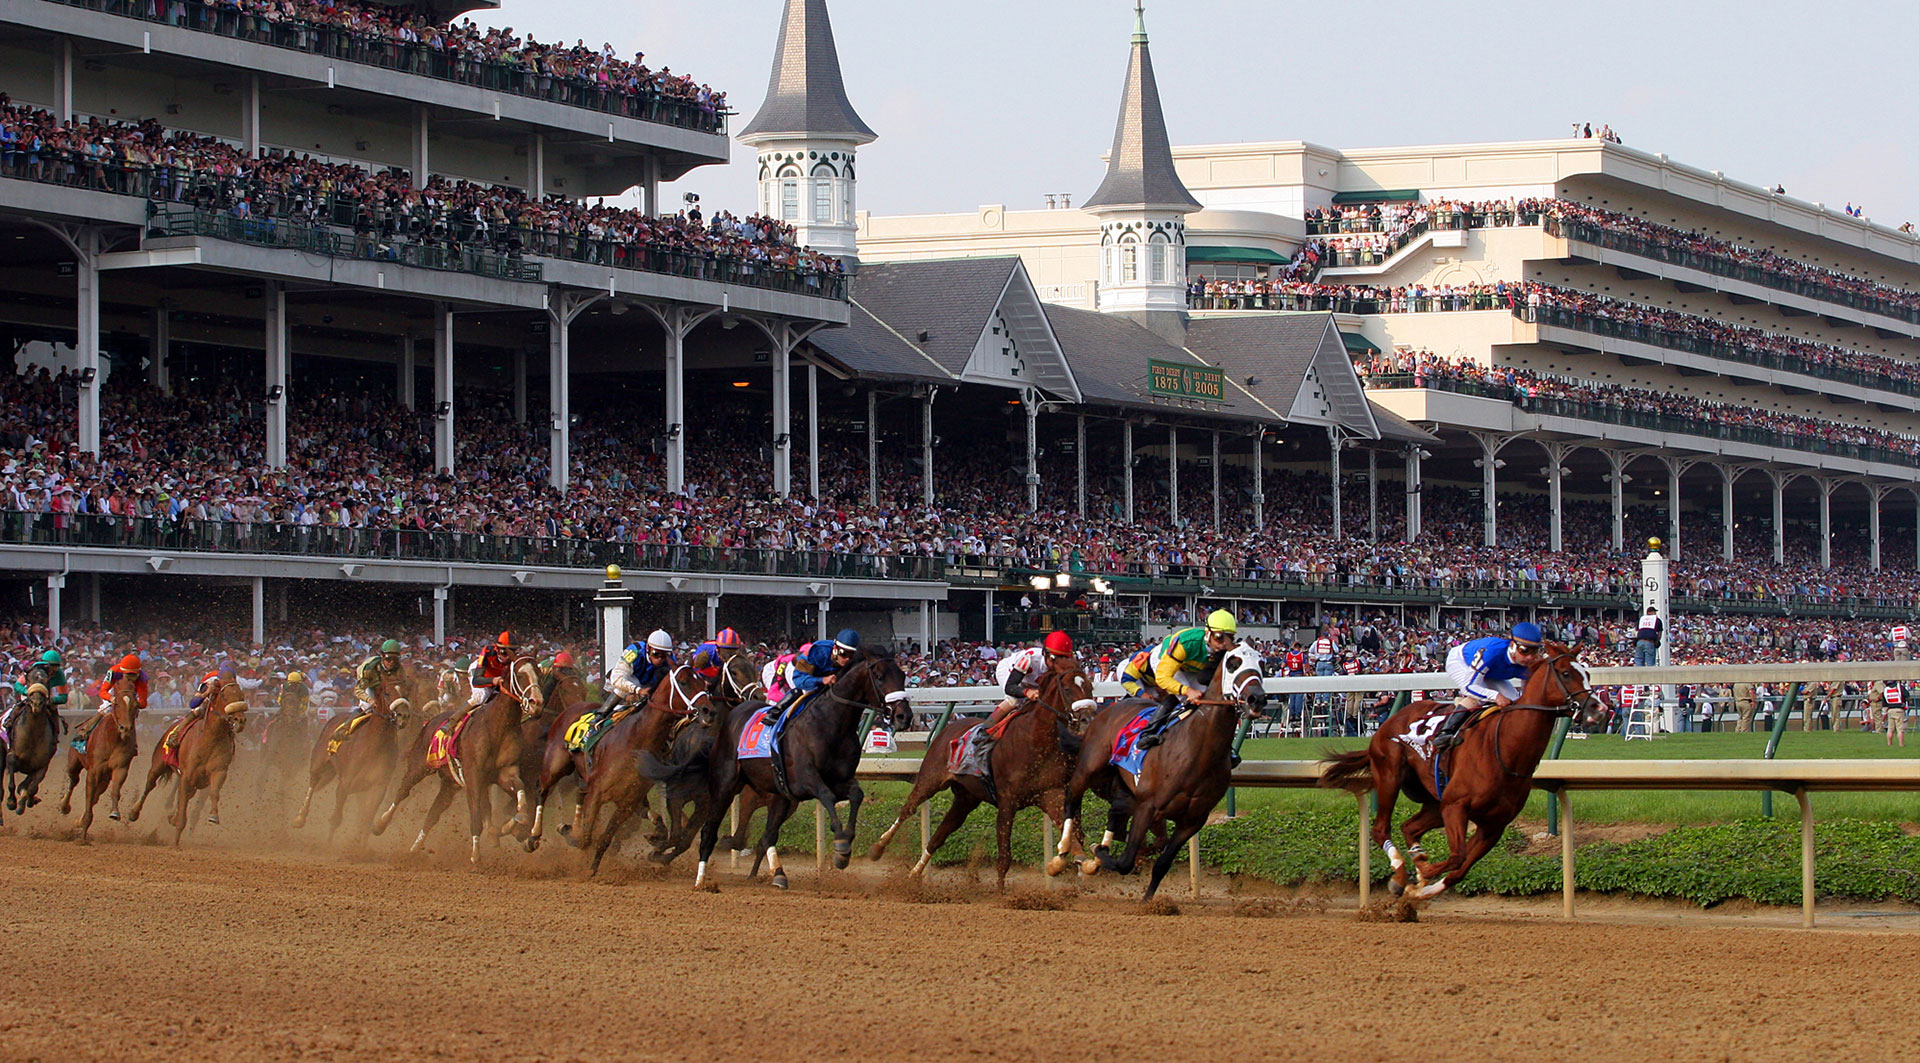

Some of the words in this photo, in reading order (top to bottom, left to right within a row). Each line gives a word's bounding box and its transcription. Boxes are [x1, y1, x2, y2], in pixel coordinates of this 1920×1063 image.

[1154, 376, 1179, 391] 1875
[1195, 381, 1219, 396] 2005
[623, 650, 637, 664] 18
[776, 663, 785, 675] 6
[739, 711, 769, 750] 16
